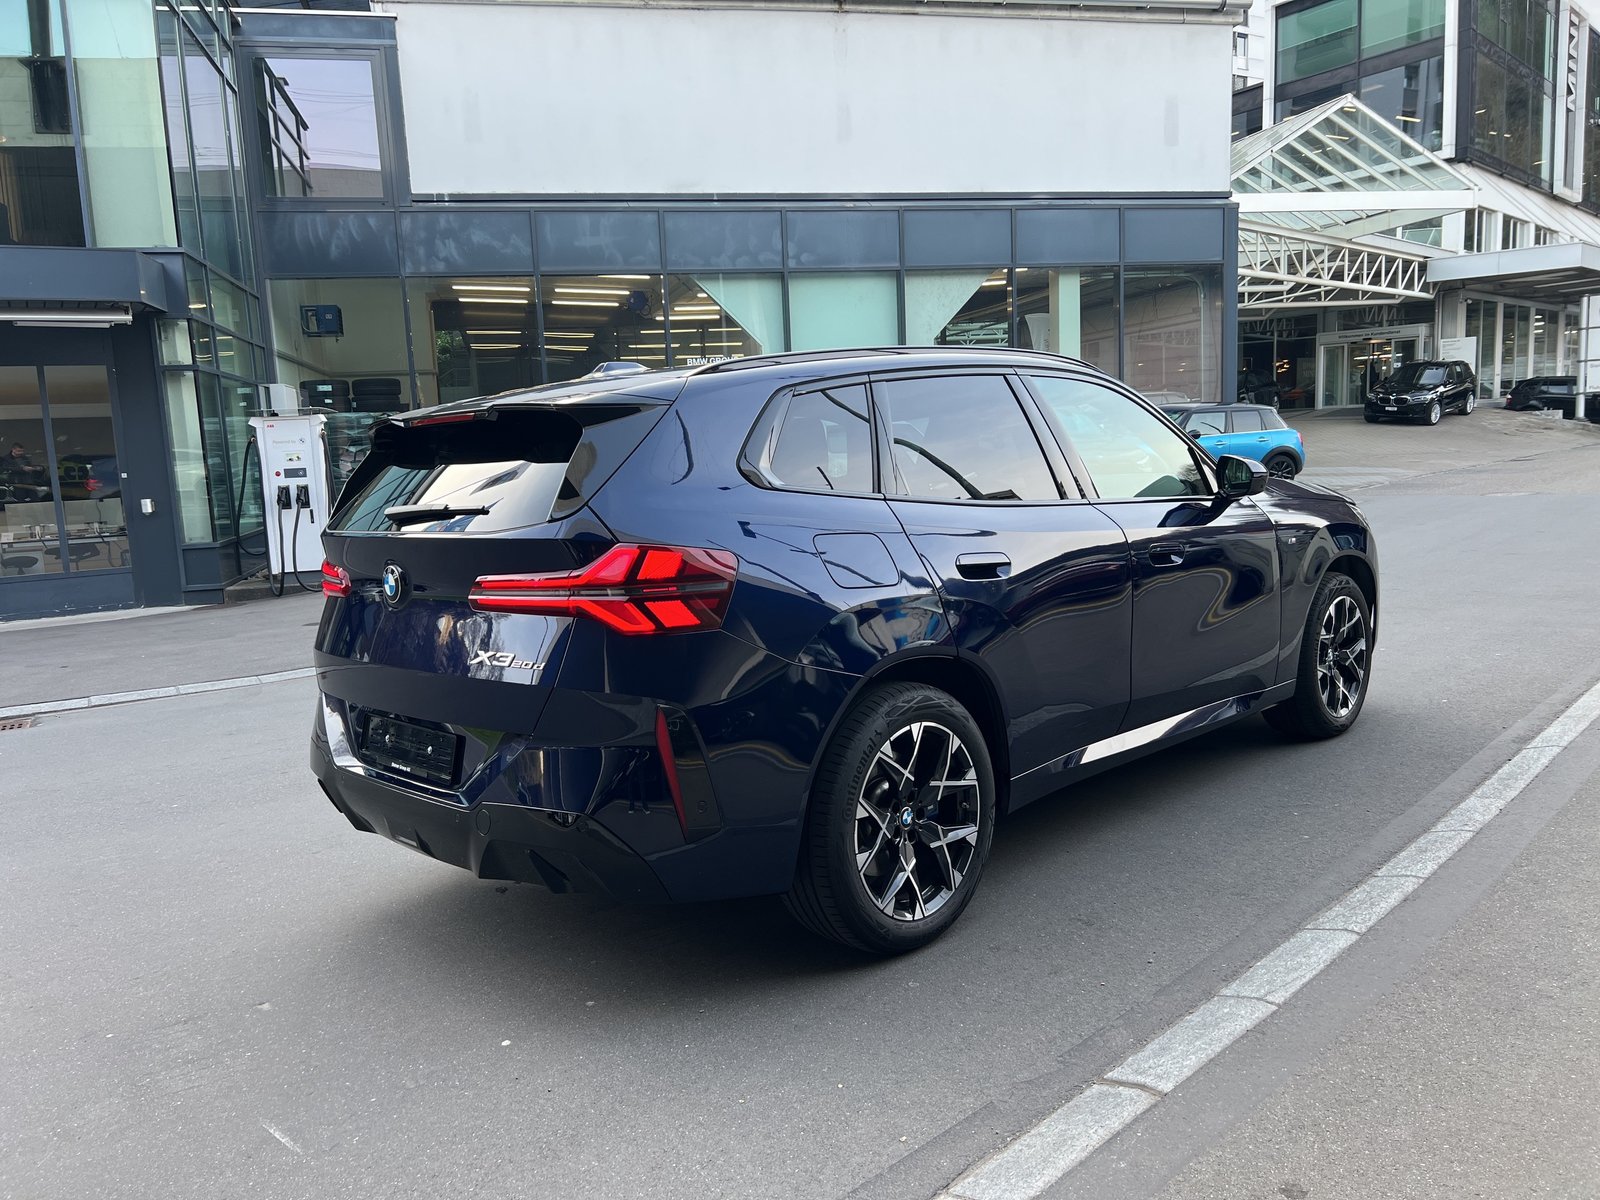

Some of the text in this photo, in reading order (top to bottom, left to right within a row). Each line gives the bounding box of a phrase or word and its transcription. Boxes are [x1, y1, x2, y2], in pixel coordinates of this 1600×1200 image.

[1567, 12, 1579, 112] MINI
[687, 357, 708, 366] BMW
[469, 650, 546, 670] X3 20d
